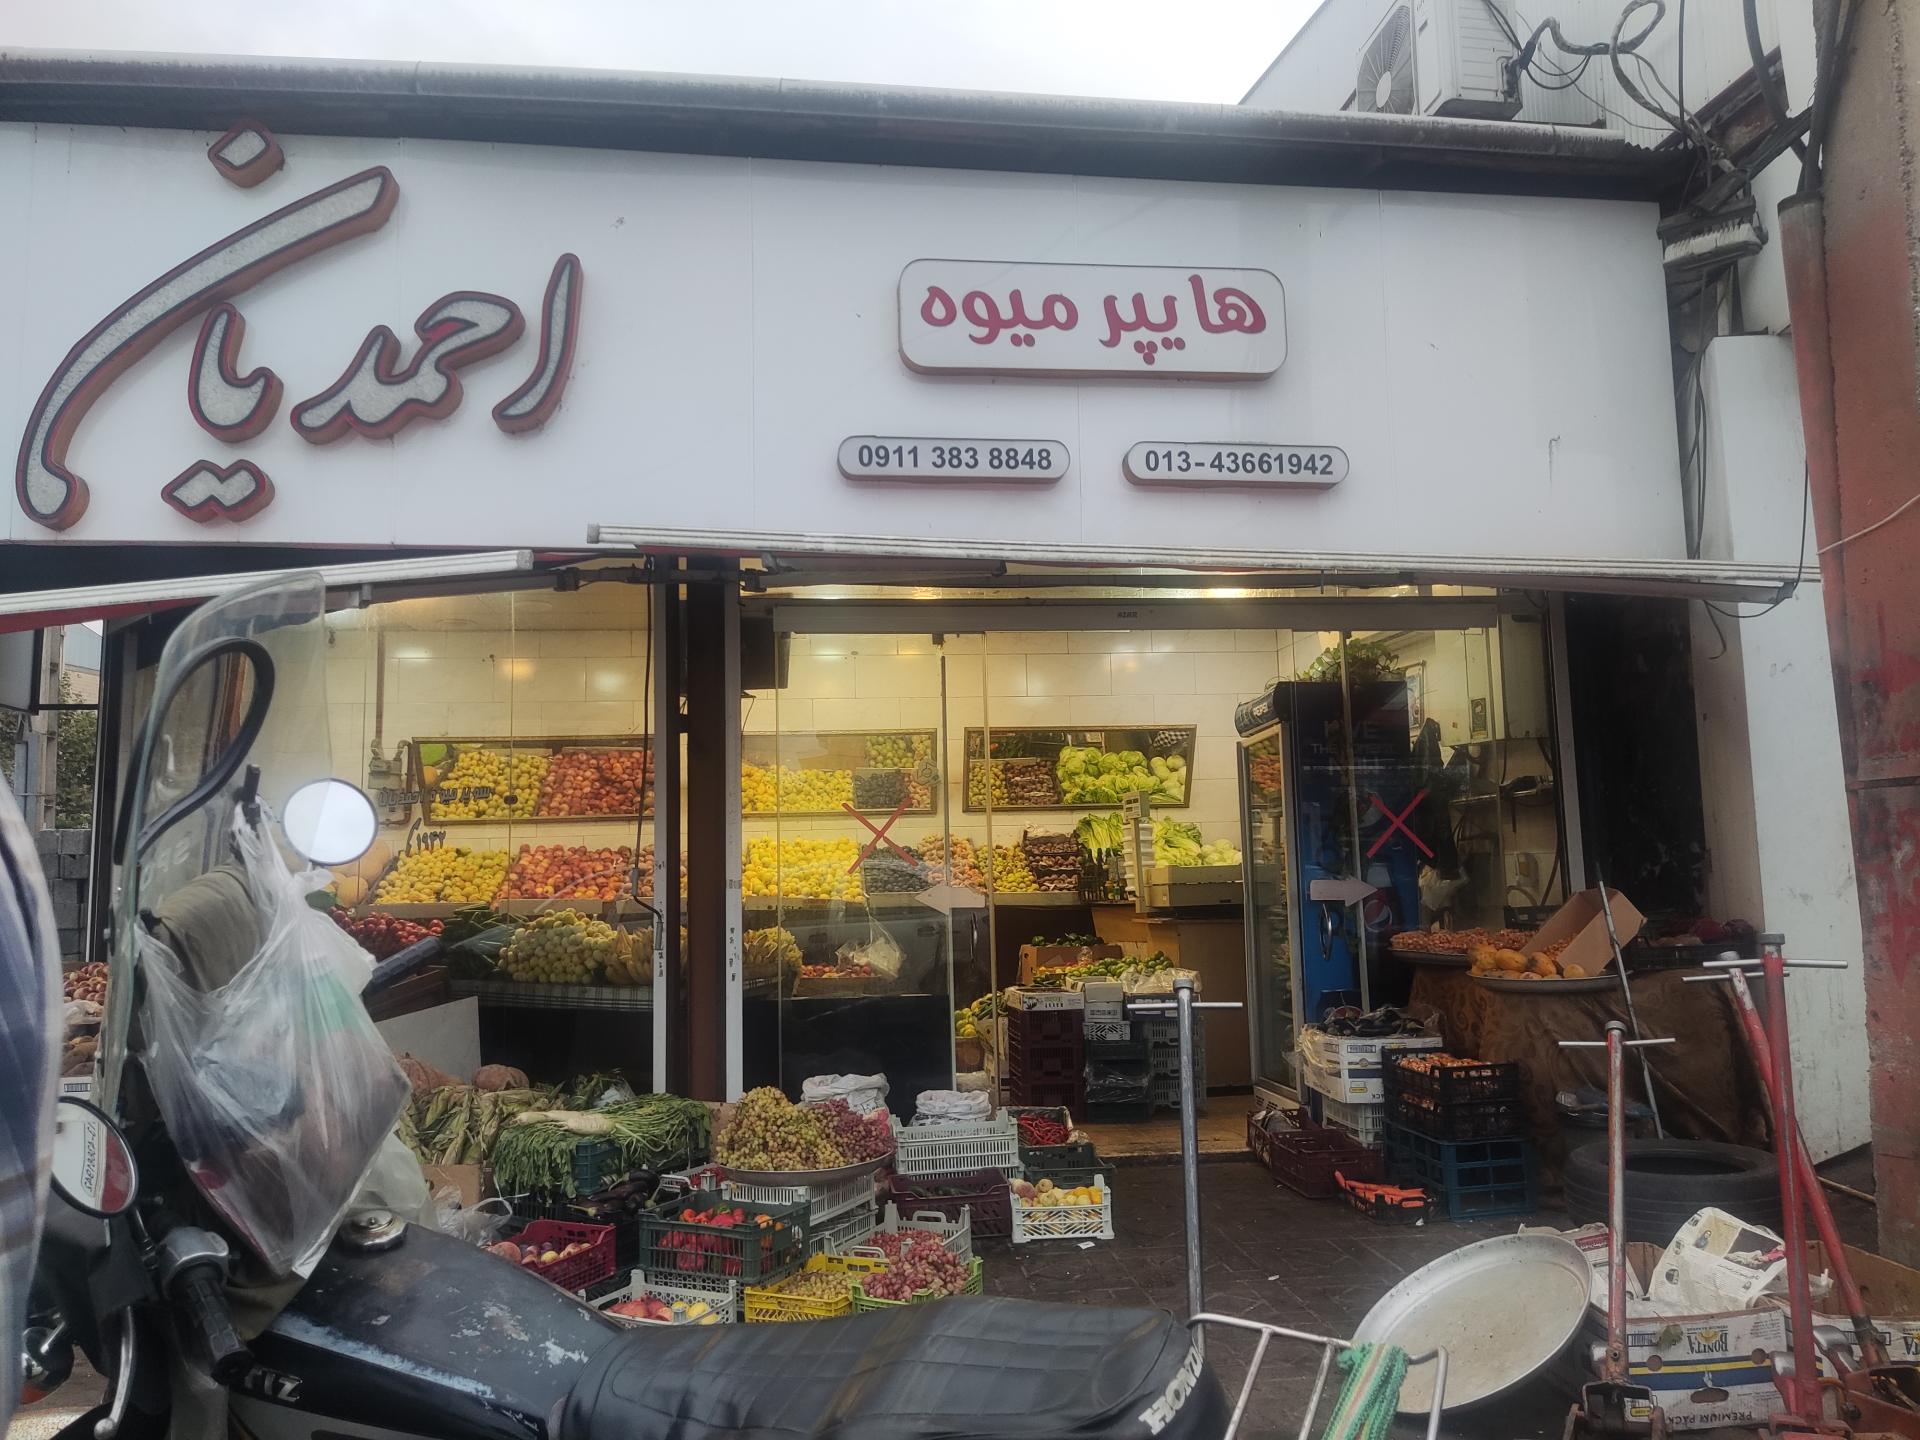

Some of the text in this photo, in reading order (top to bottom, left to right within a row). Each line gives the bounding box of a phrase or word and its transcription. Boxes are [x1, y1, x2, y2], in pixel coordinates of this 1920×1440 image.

[920, 274, 1267, 365] هایپر میوه
[858, 444, 1053, 471] 0911 383 8848
[1144, 449, 1334, 476] 013-43661942
[1685, 1332, 1729, 1355] BONITA
[1667, 1411, 1753, 1425] PREMIUM PACK
